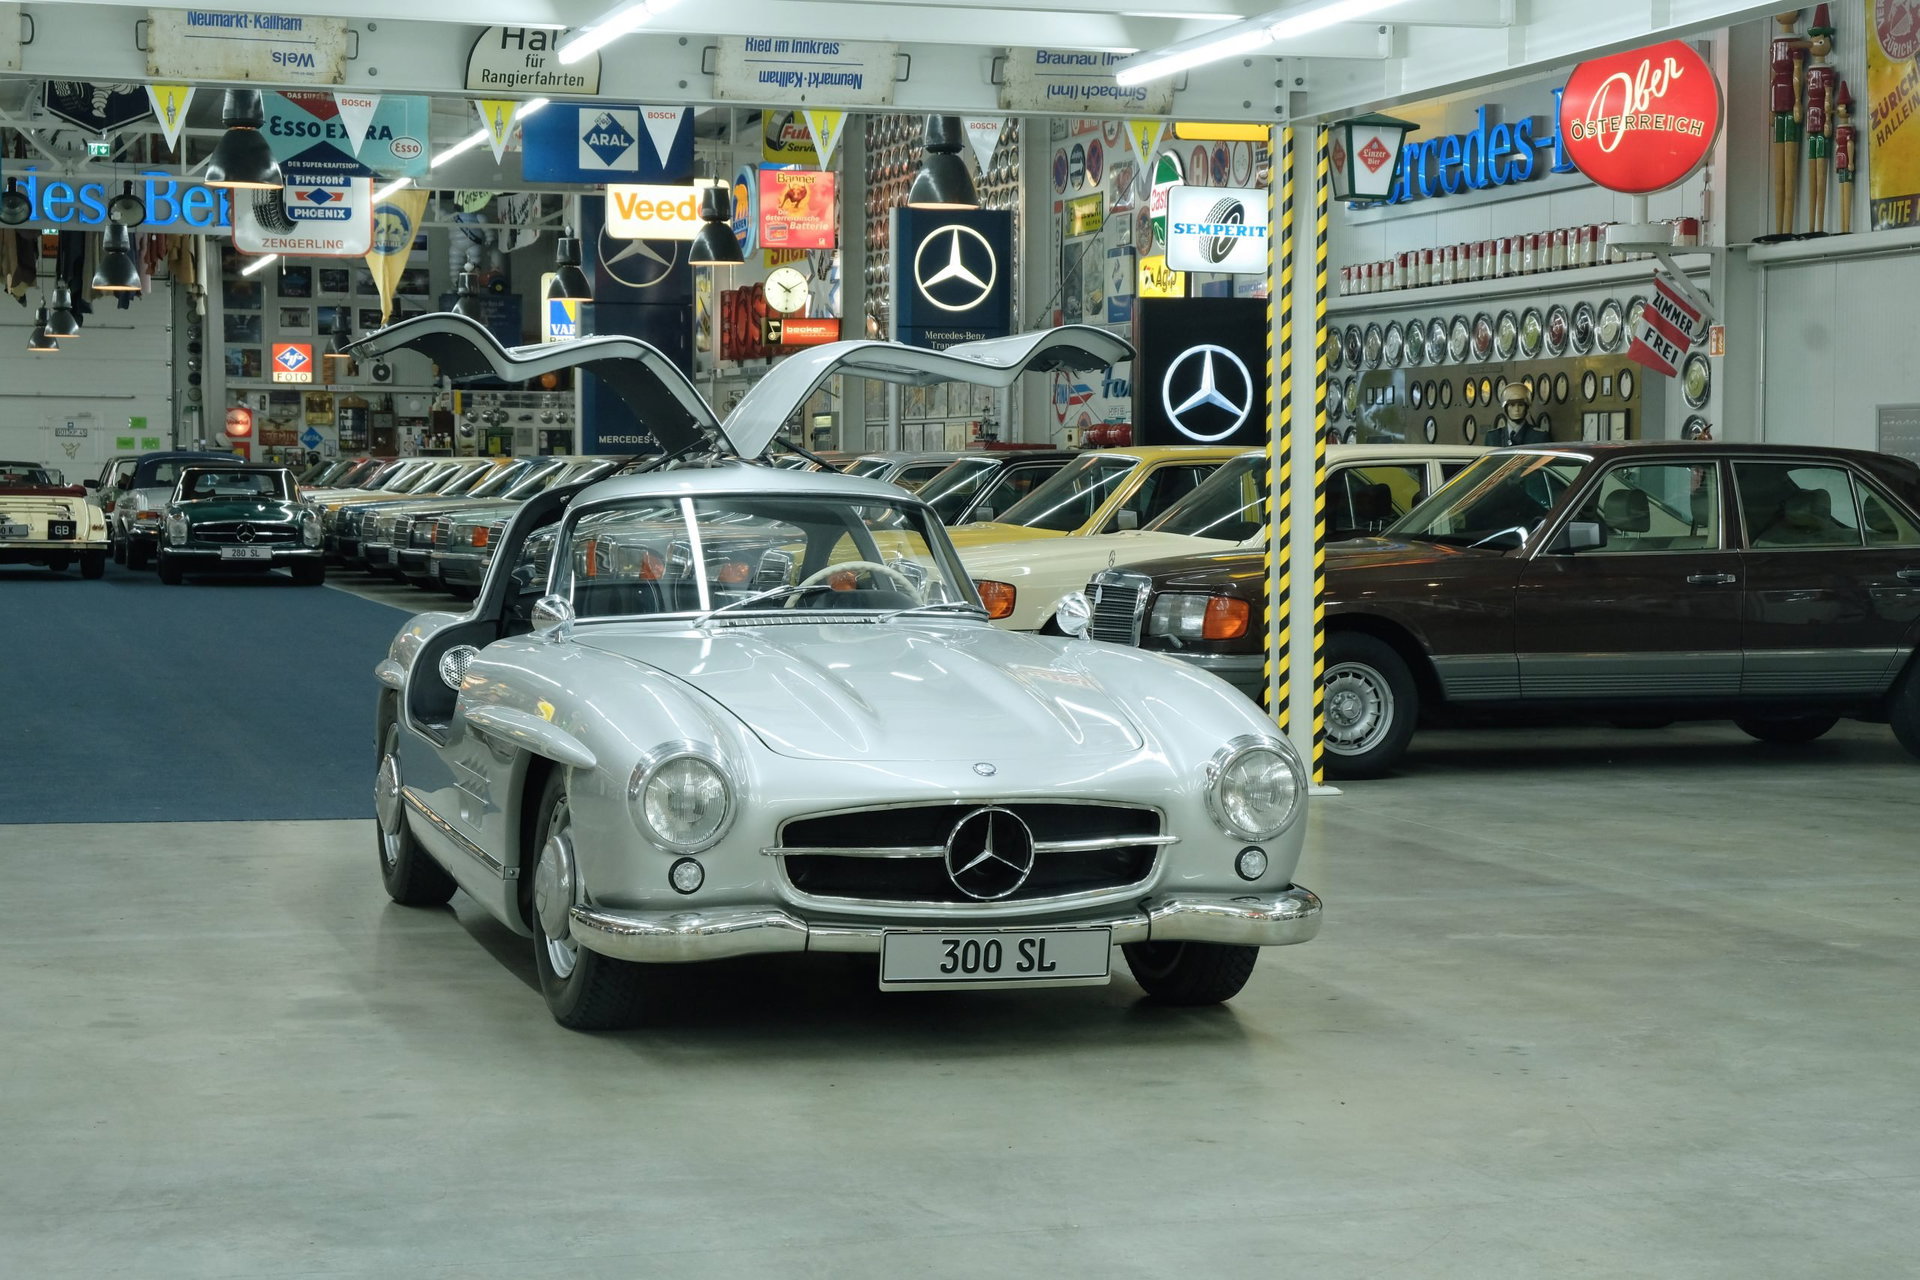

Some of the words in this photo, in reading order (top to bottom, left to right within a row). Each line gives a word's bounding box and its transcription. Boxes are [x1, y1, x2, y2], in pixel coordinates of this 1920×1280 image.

[501, 26, 567, 51] Hal
[745, 37, 771, 52] Ried
[775, 39, 789, 53] im
[791, 39, 840, 55] Innkreis
[272, 51, 315, 68] Wels
[525, 53, 546, 68] für
[1036, 50, 1097, 66] Braunau
[481, 69, 585, 88] Rangierfahrten
[1081, 85, 1147, 100] Simbach
[341, 98, 372, 107] BOSCH
[1586, 57, 1684, 153] Ober
[647, 111, 676, 120] BOSCH
[325, 123, 393, 141] EXRA
[970, 121, 997, 130] BOSCH
[1571, 112, 1705, 141] ÖSTERREICH
[589, 133, 629, 147] ARAL
[1363, 149, 1386, 158] Linzer
[294, 176, 345, 185] Firestone
[776, 173, 816, 184] Banner
[294, 208, 346, 219] PHOENIX
[614, 191, 703, 221] Veed
[1877, 199, 1912, 225] GUTE
[789, 221, 829, 231] Batterie
[1174, 222, 1267, 238] SEMPERIT
[262, 239, 344, 249] ZENGERLING
[1652, 291, 1693, 337] ZIMMER
[786, 326, 826, 334] becker
[925, 330, 986, 340] Mercedes-Benz
[1643, 327, 1679, 365] FREI
[276, 373, 308, 381] FOTO
[54, 525, 69, 535] GB
[231, 548, 246, 557] 280
[250, 548, 260, 557] SL
[940, 938, 1003, 974] 300
[1016, 937, 1057, 973] SL
